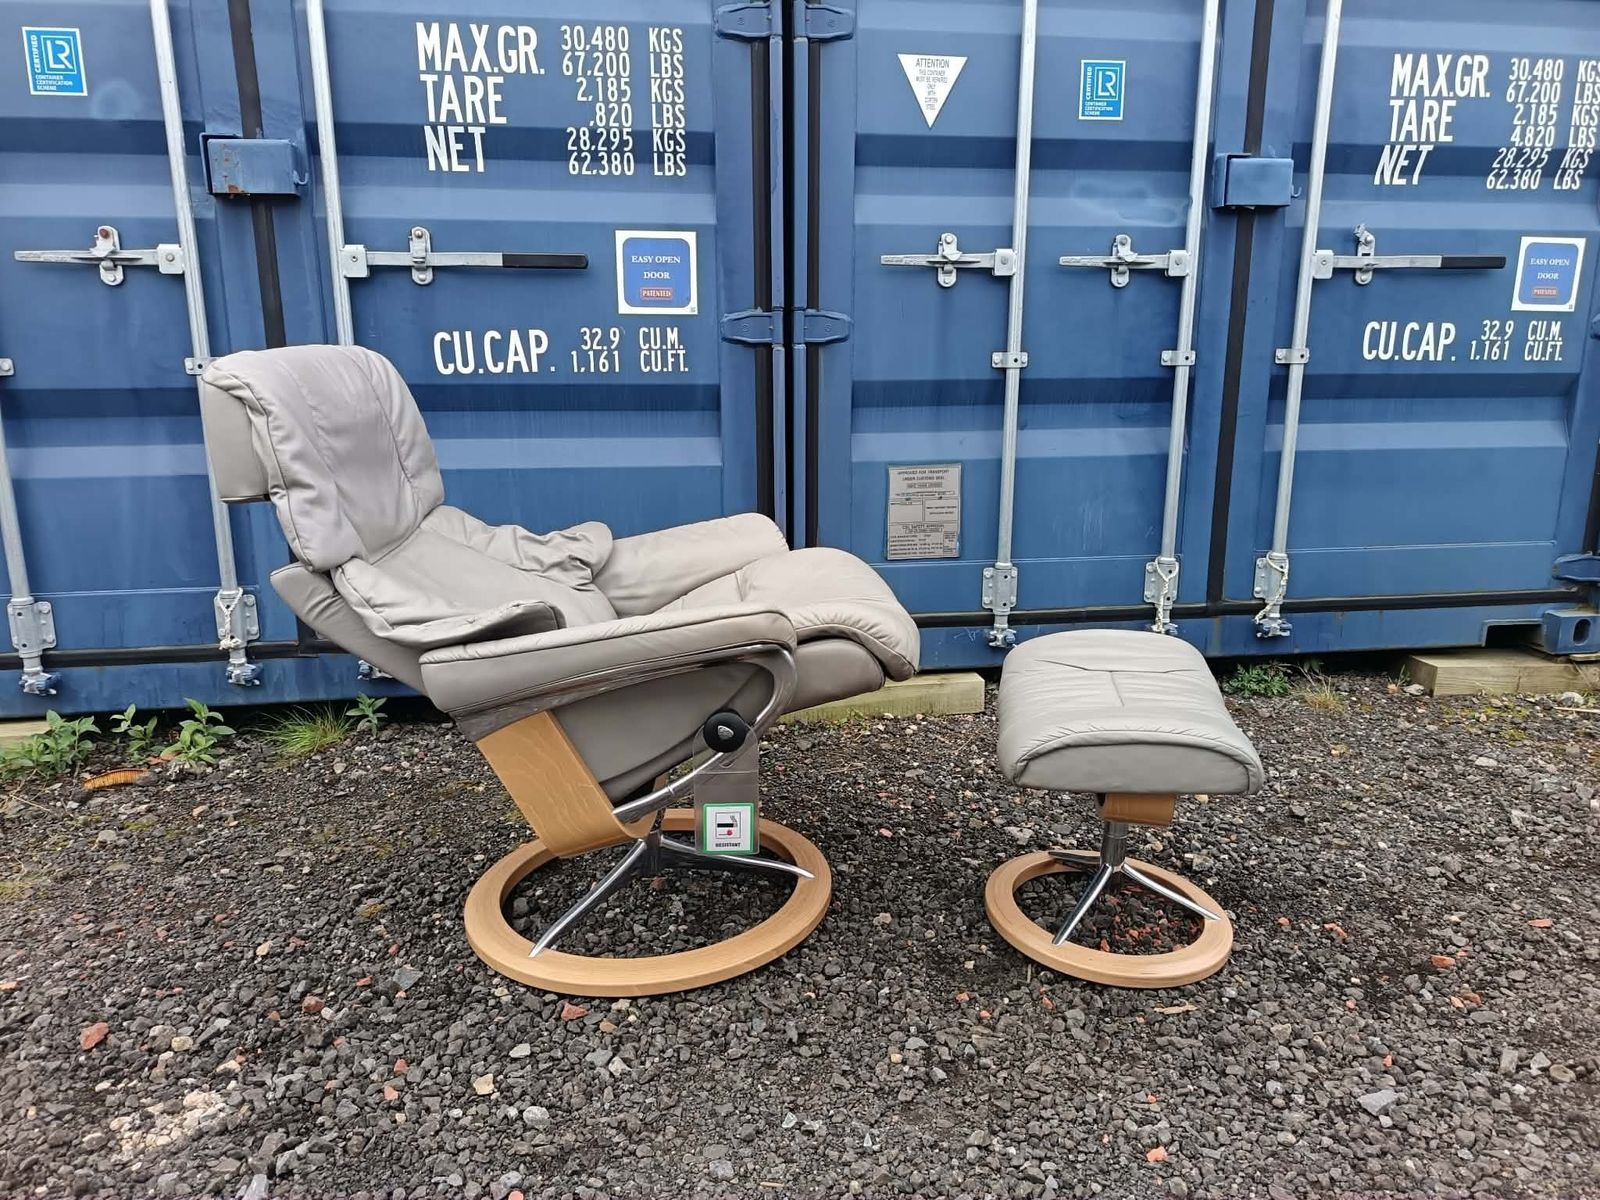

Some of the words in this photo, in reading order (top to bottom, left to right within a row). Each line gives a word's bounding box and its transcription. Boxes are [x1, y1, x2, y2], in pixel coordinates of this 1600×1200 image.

[30, 35, 41, 73] CERTIFIED
[46, 40, 74, 69] LR
[416, 22, 545, 75] MAX.GR.
[560, 25, 629, 51] 30,480
[649, 27, 683, 53] KGS
[562, 52, 630, 77] 67,200
[650, 53, 684, 79] LBS
[915, 58, 950, 69] ATTENTION
[1390, 53, 1491, 98] MAX.GR.
[1509, 58, 1564, 81] 30,480
[576, 77, 631, 102] 2,185
[650, 79, 685, 103] KGS
[1085, 66, 1093, 100] CERTIFIED
[1098, 70, 1117, 97] LR
[1506, 81, 1561, 103] 67,200
[1574, 82, 1600, 104] LBS
[420, 74, 507, 125] TARE
[651, 104, 686, 129] LBS
[1389, 100, 1457, 142] TARE
[1513, 104, 1558, 125] 2,185
[1571, 105, 1599, 126] KGS
[424, 125, 486, 173] NET
[566, 127, 633, 152] 28,295
[652, 129, 686, 153] KGS
[1510, 126, 1555, 147] 4,820
[1568, 127, 1597, 148] LBS
[568, 152, 635, 176] 62,380
[653, 153, 687, 177] LBS
[1373, 145, 1434, 185] NET
[1492, 147, 1551, 168] 28,295
[1560, 148, 1593, 169] KGS
[1486, 169, 1542, 190] 62,380
[1553, 169, 1584, 190] LBS
[631, 255, 654, 264] EASY
[655, 255, 681, 264] OPEN
[1530, 257, 1549, 265] EASY
[1549, 258, 1570, 266] OPEN
[643, 271, 671, 280] DOOR
[1537, 272, 1559, 280] DOOR
[433, 329, 556, 375] CU.CAP.
[580, 327, 620, 350] 32.9
[639, 327, 684, 350] CU.M.
[1362, 321, 1456, 361] CU.CAP.
[1481, 320, 1514, 341] 32.9
[1527, 321, 1563, 341] CU.M.
[1524, 341, 1563, 361] CU.FT.
[639, 350, 689, 373] CU.FT.
